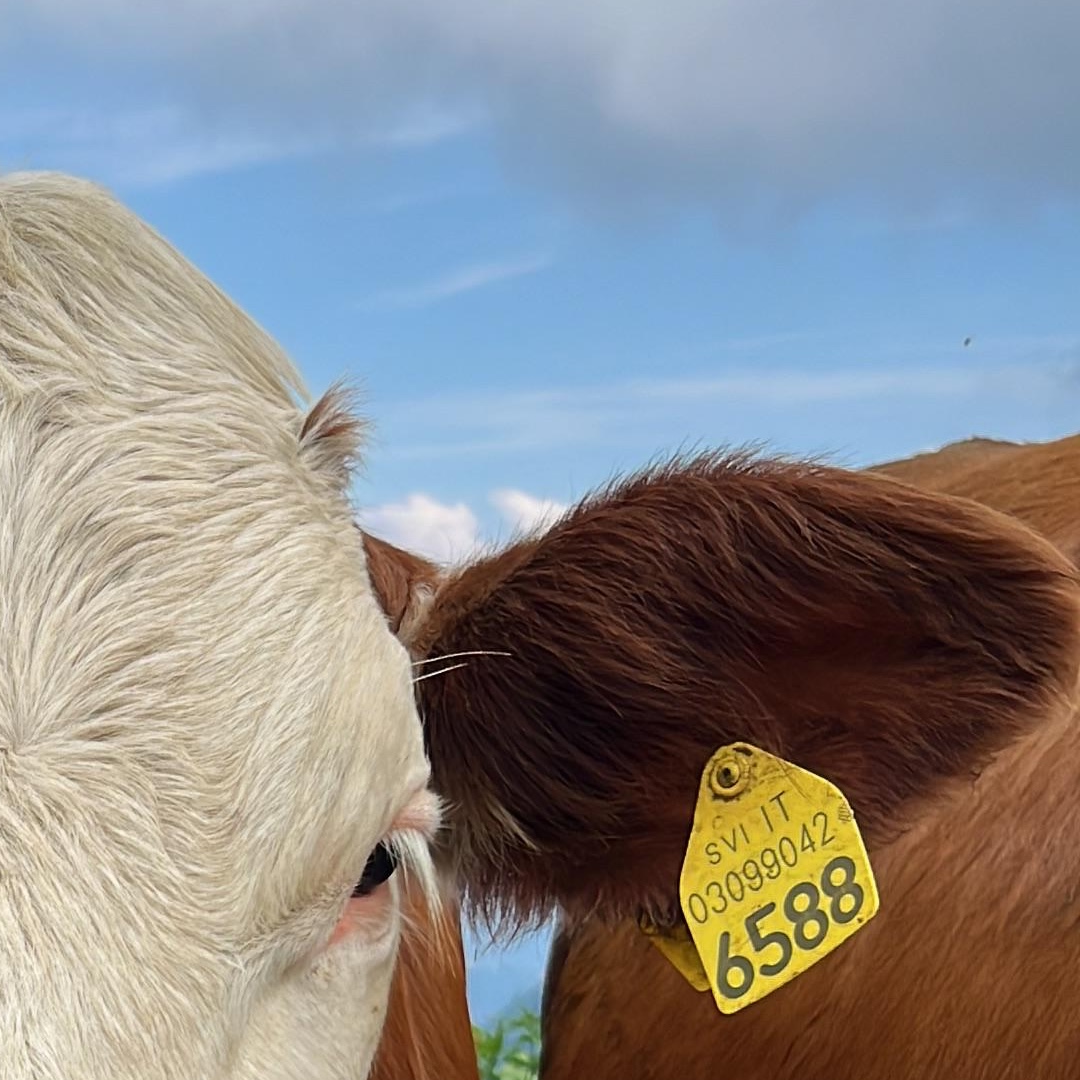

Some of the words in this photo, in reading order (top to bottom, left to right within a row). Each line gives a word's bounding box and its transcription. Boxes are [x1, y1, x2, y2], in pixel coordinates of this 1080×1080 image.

[688, 811, 836, 924] 03099042
[705, 823, 750, 865] SVI
[760, 790, 790, 833] IT
[716, 855, 865, 999] 6588
